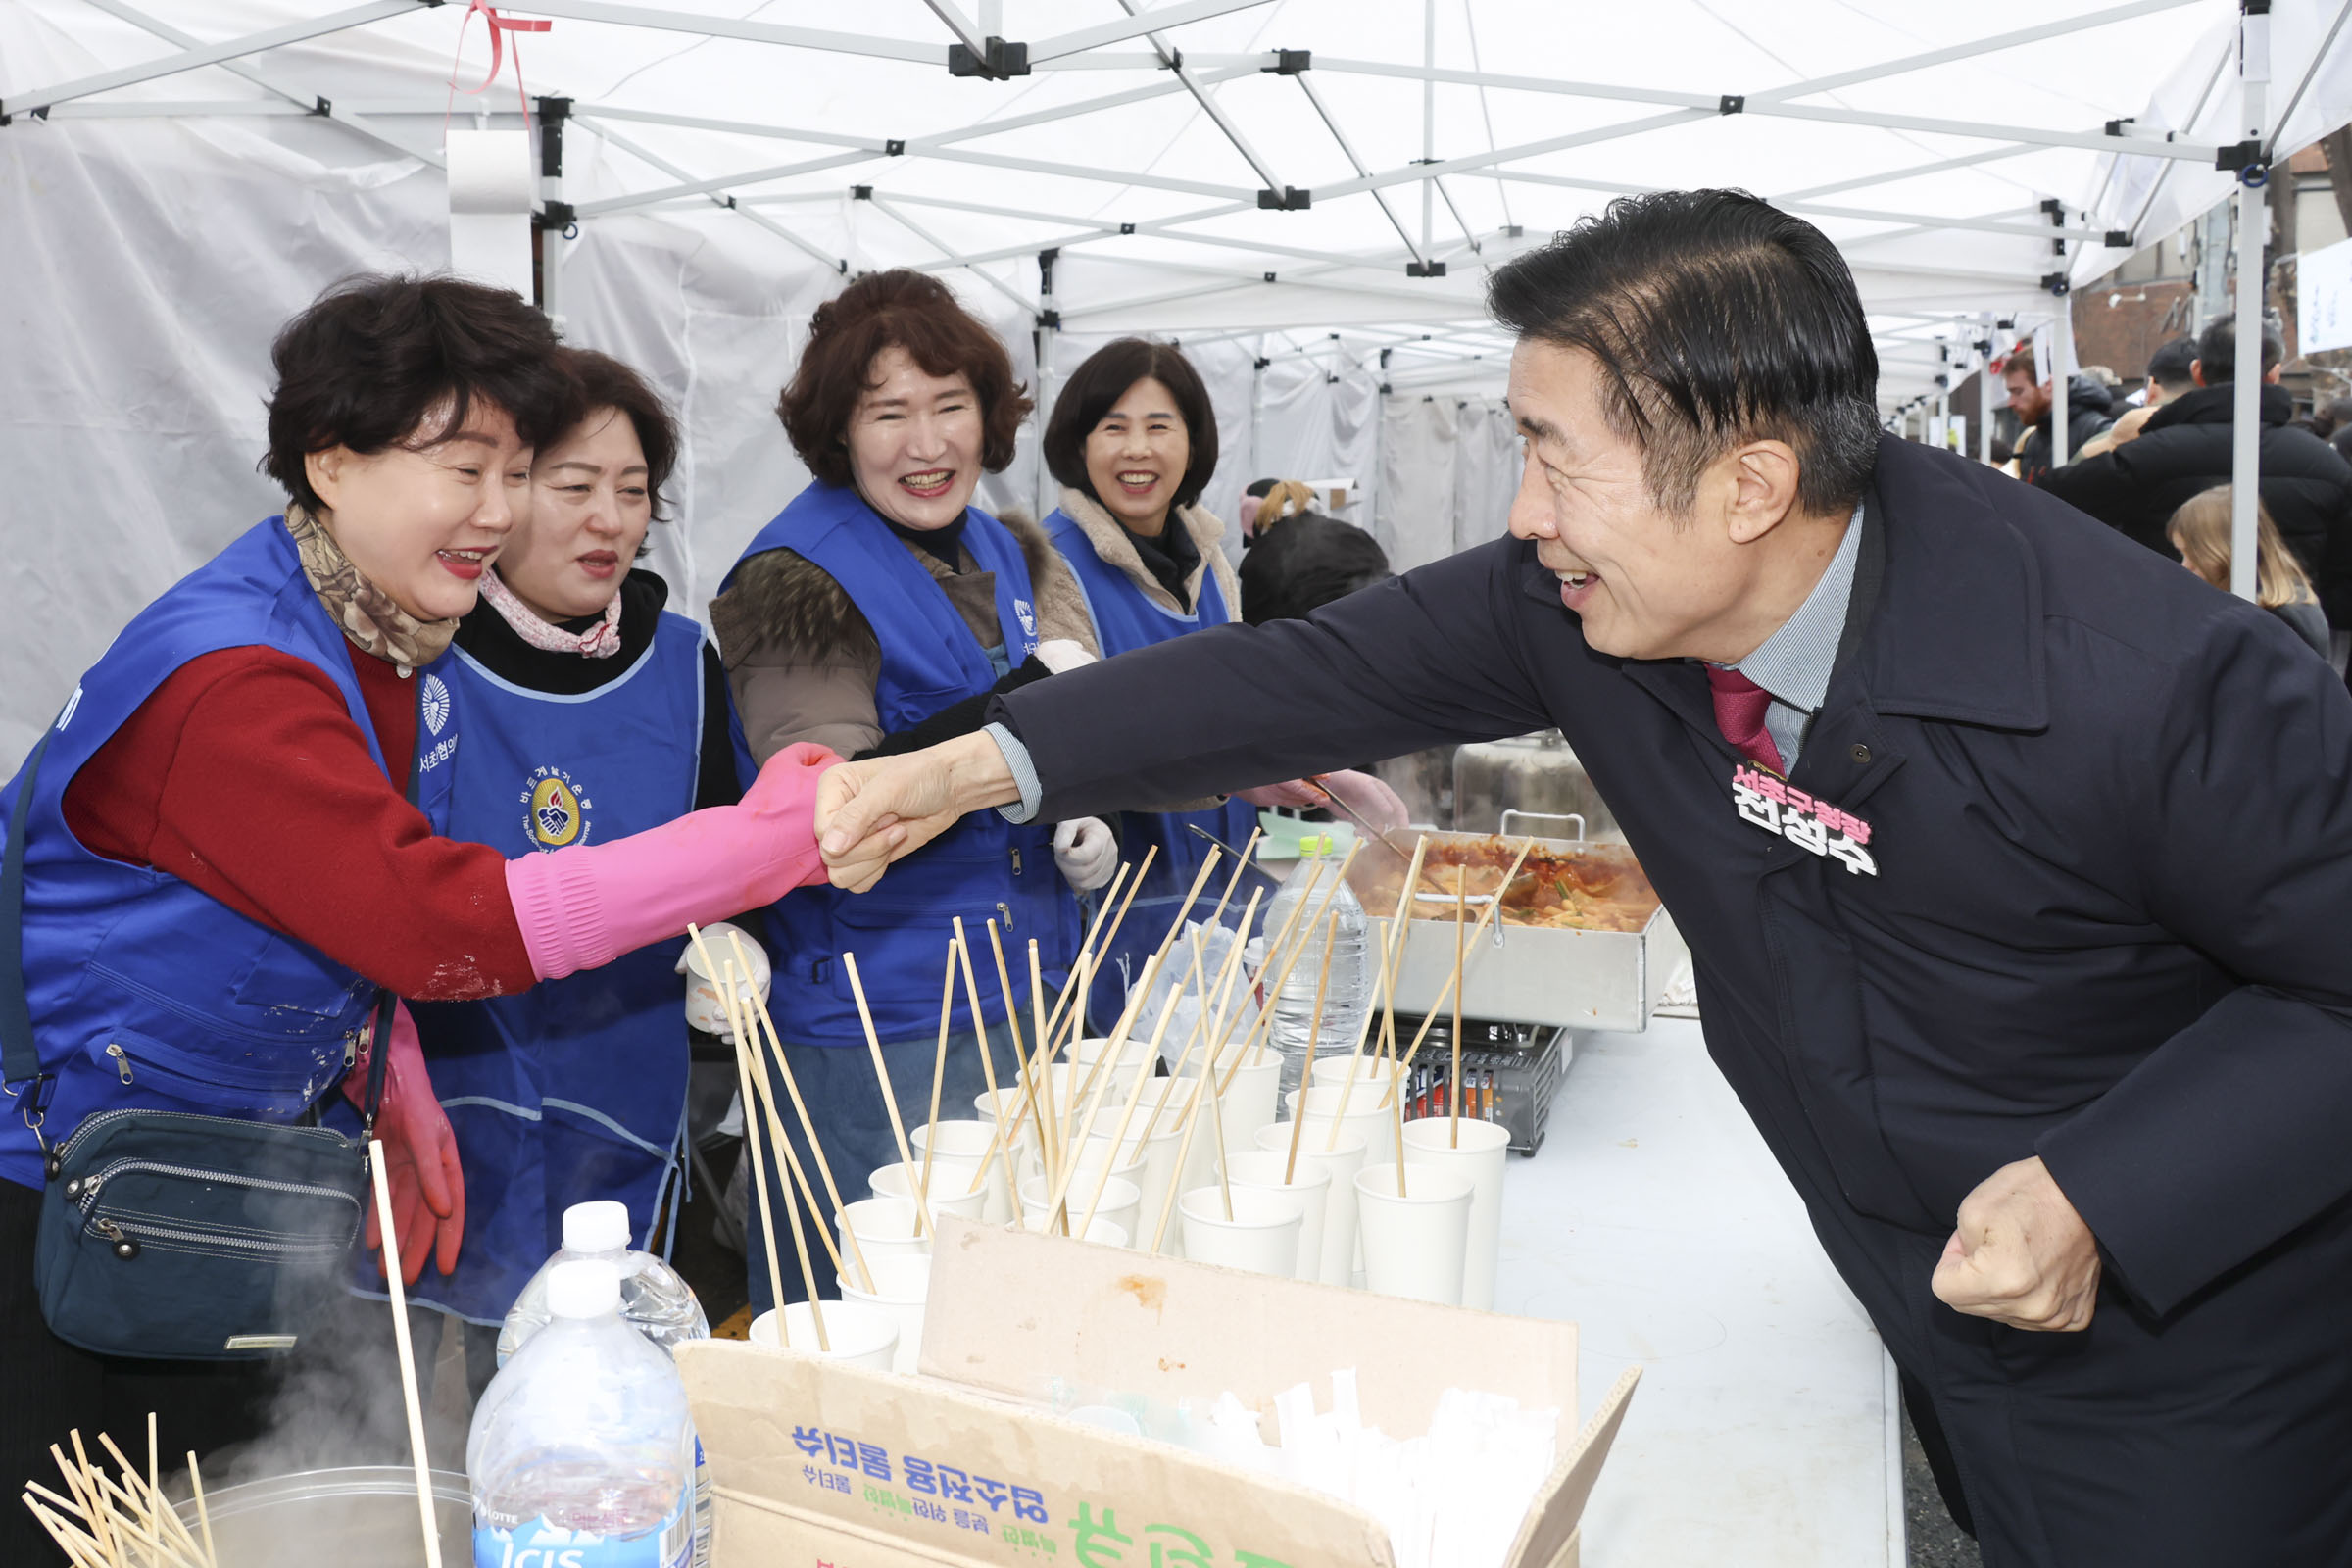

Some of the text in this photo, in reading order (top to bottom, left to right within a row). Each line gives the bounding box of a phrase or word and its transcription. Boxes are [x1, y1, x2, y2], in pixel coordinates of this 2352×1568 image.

[1732, 782, 1877, 876] 전성수
[1733, 764, 1872, 845] 서초구청장
[791, 1426, 1049, 1524] 업소전용 물티슈
[802, 1464, 852, 1494] 물티슈
[911, 1497, 947, 1523] 위한
[952, 1508, 990, 1535] 분을
